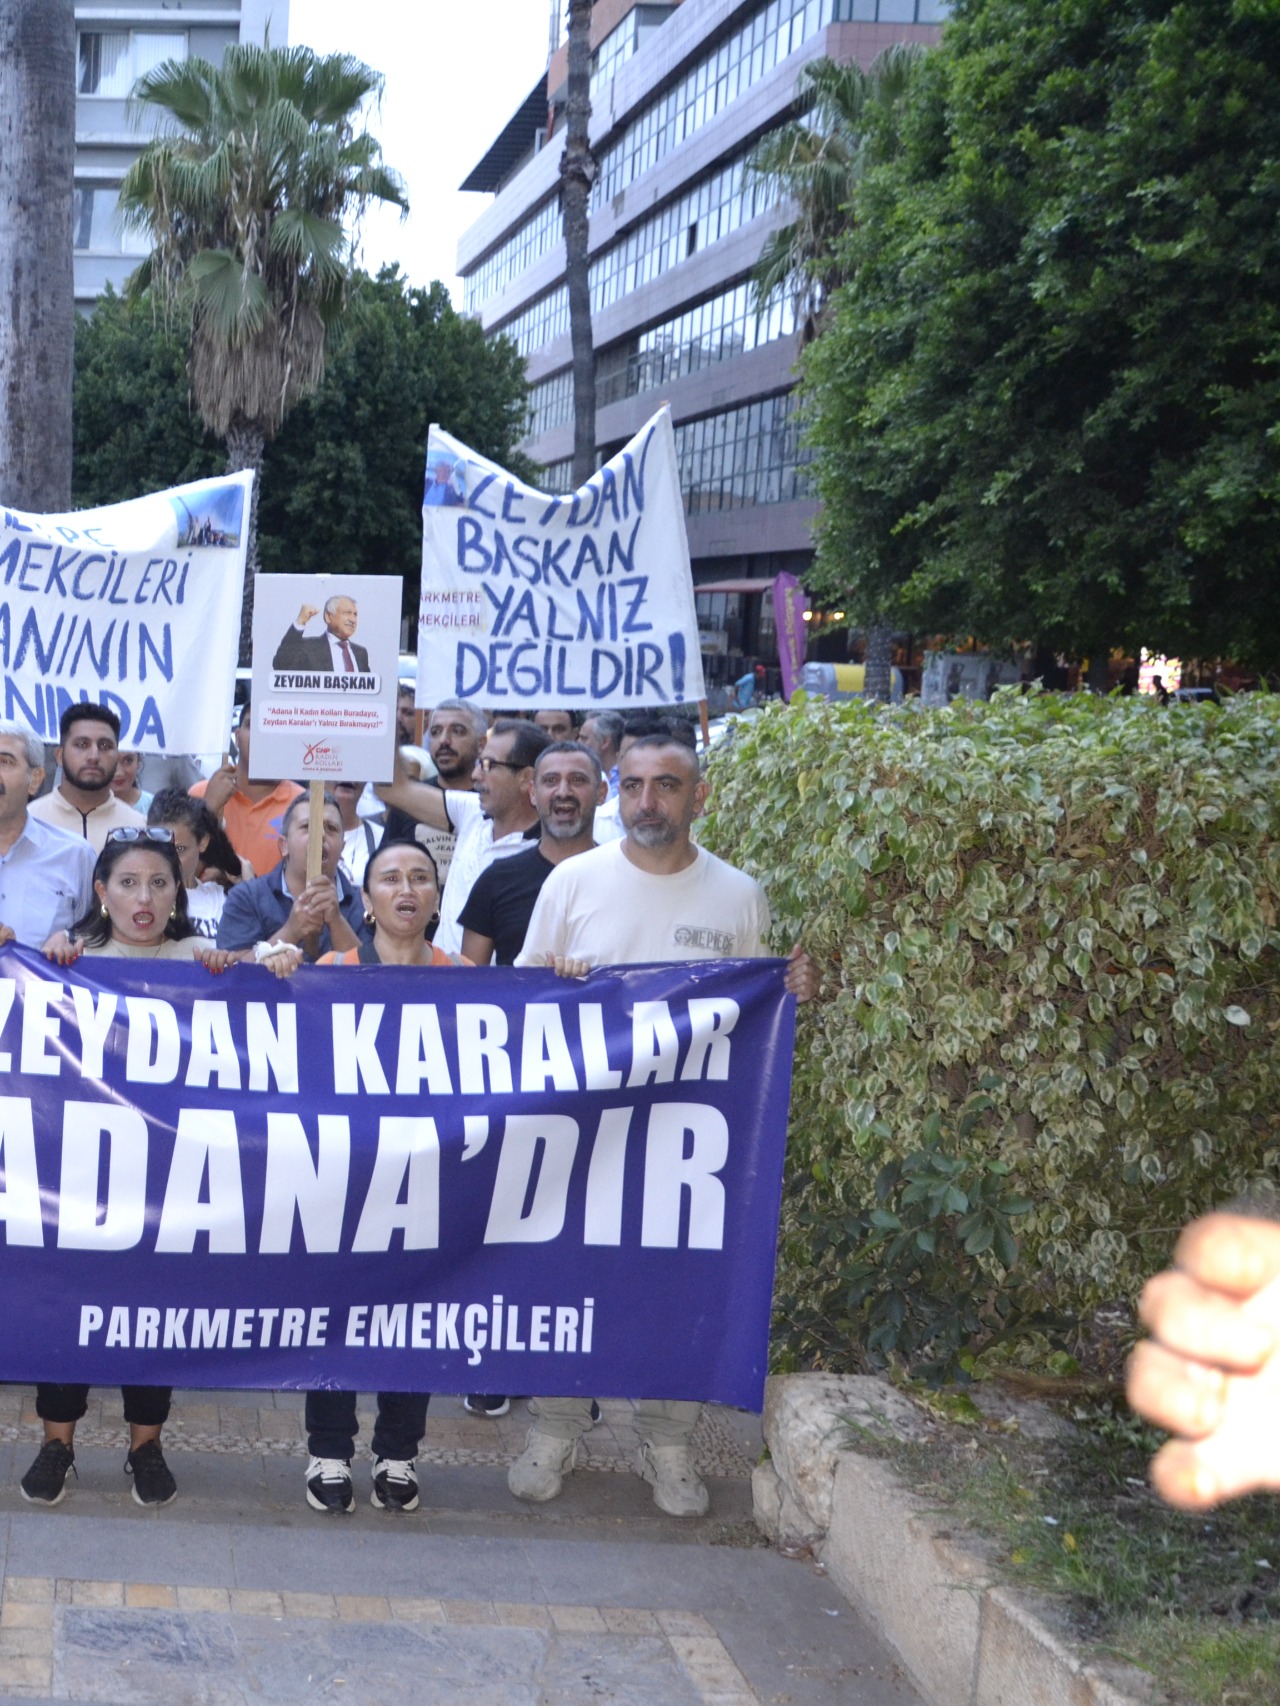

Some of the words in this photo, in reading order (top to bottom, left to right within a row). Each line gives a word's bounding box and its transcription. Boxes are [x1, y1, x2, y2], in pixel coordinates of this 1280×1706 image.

[481, 575, 654, 642] YALNIZ
[274, 674, 321, 689] ZEYDAN
[323, 675, 376, 692] BAŞKAN
[300, 708, 319, 716] Kadın
[263, 717, 289, 727] Zeydan
[318, 719, 338, 727] Yalnız
[426, 835, 451, 844] ALVIN
[331, 997, 741, 1096] KARALAR
[78, 1303, 330, 1349] PARKMETRE
[345, 1294, 596, 1366] EMEKÇİLERİ
